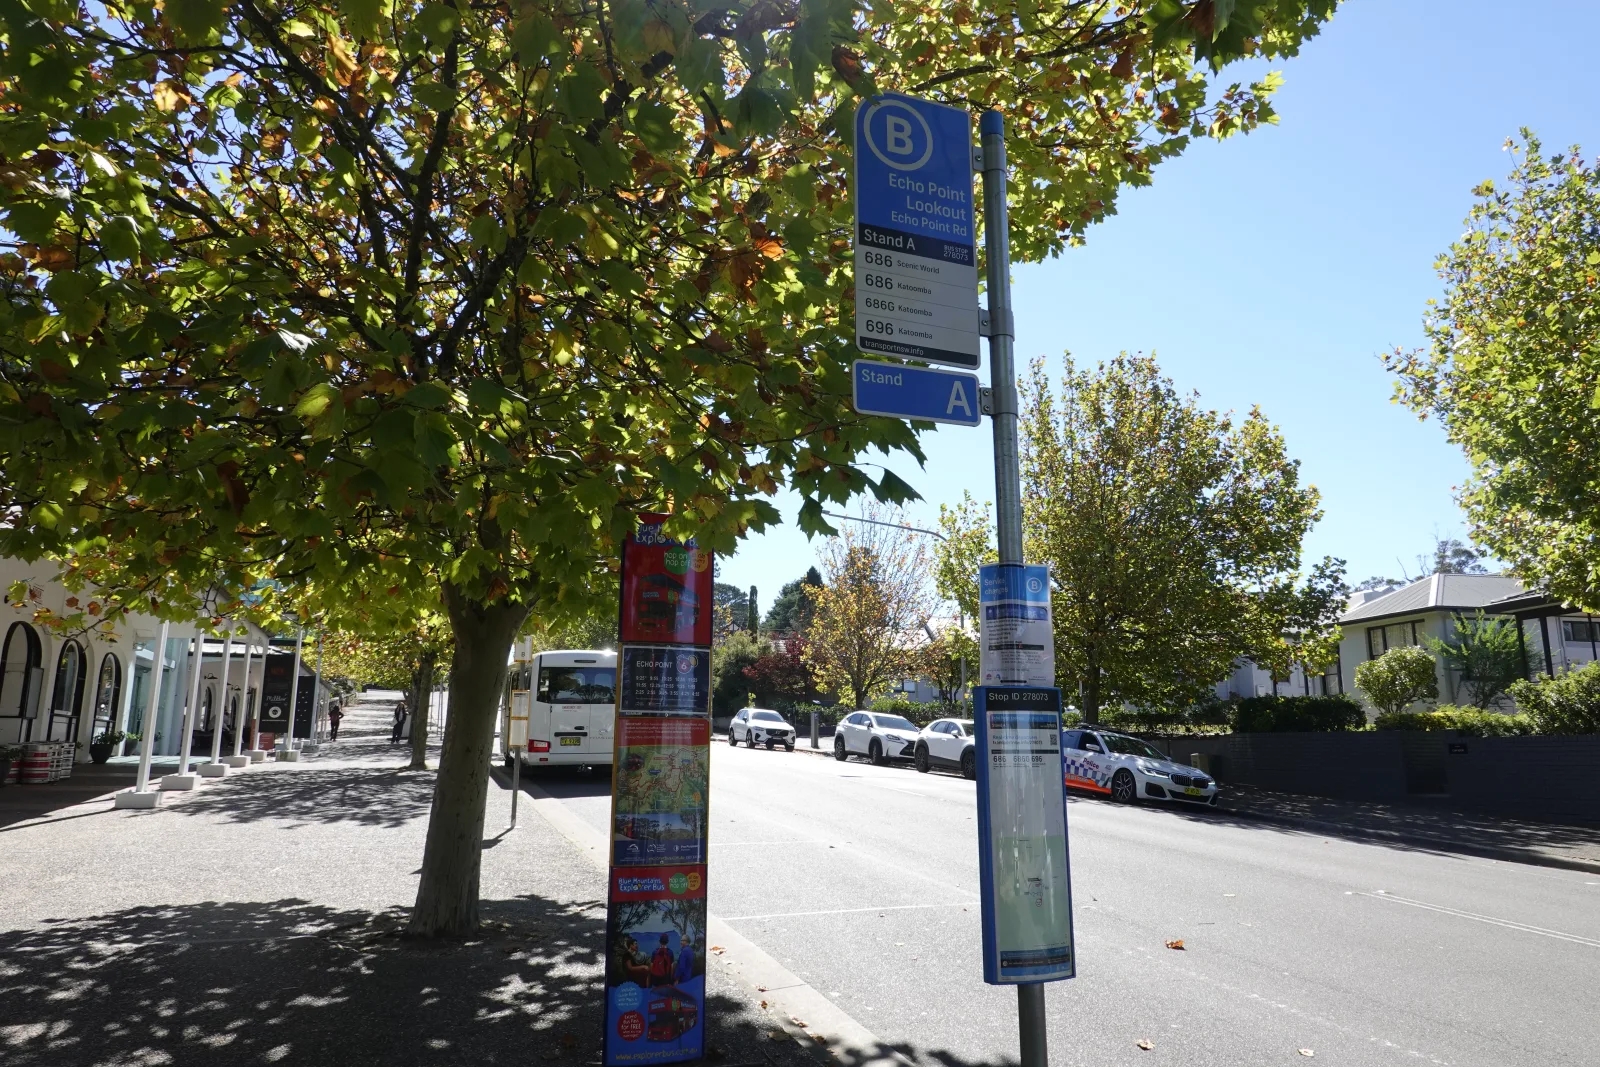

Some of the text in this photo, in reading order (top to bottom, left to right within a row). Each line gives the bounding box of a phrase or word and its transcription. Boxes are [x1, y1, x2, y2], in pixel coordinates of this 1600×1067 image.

[887, 114, 913, 155] B
[889, 173, 965, 202] Echo Point
[907, 196, 966, 221] Lookout
[891, 211, 967, 236] Echo Point Rd
[864, 229, 915, 250] Stand A
[865, 251, 939, 274] 686 Scenic World
[944, 251, 968, 261] 278073
[865, 274, 931, 295] 686 Katoomba
[865, 298, 932, 317] 686G Katoomba
[866, 320, 933, 339] 696 Katoomba
[865, 340, 924, 356] transportnsw.info
[862, 369, 972, 417] Stand A
[664, 551, 677, 559] hop
[665, 558, 679, 567] hop
[1031, 581, 1038, 589] B
[636, 660, 653, 668] ECHO
[681, 662, 687, 670] 6
[988, 692, 1048, 701] Stop ID 278073
[1083, 757, 1099, 769] Police
